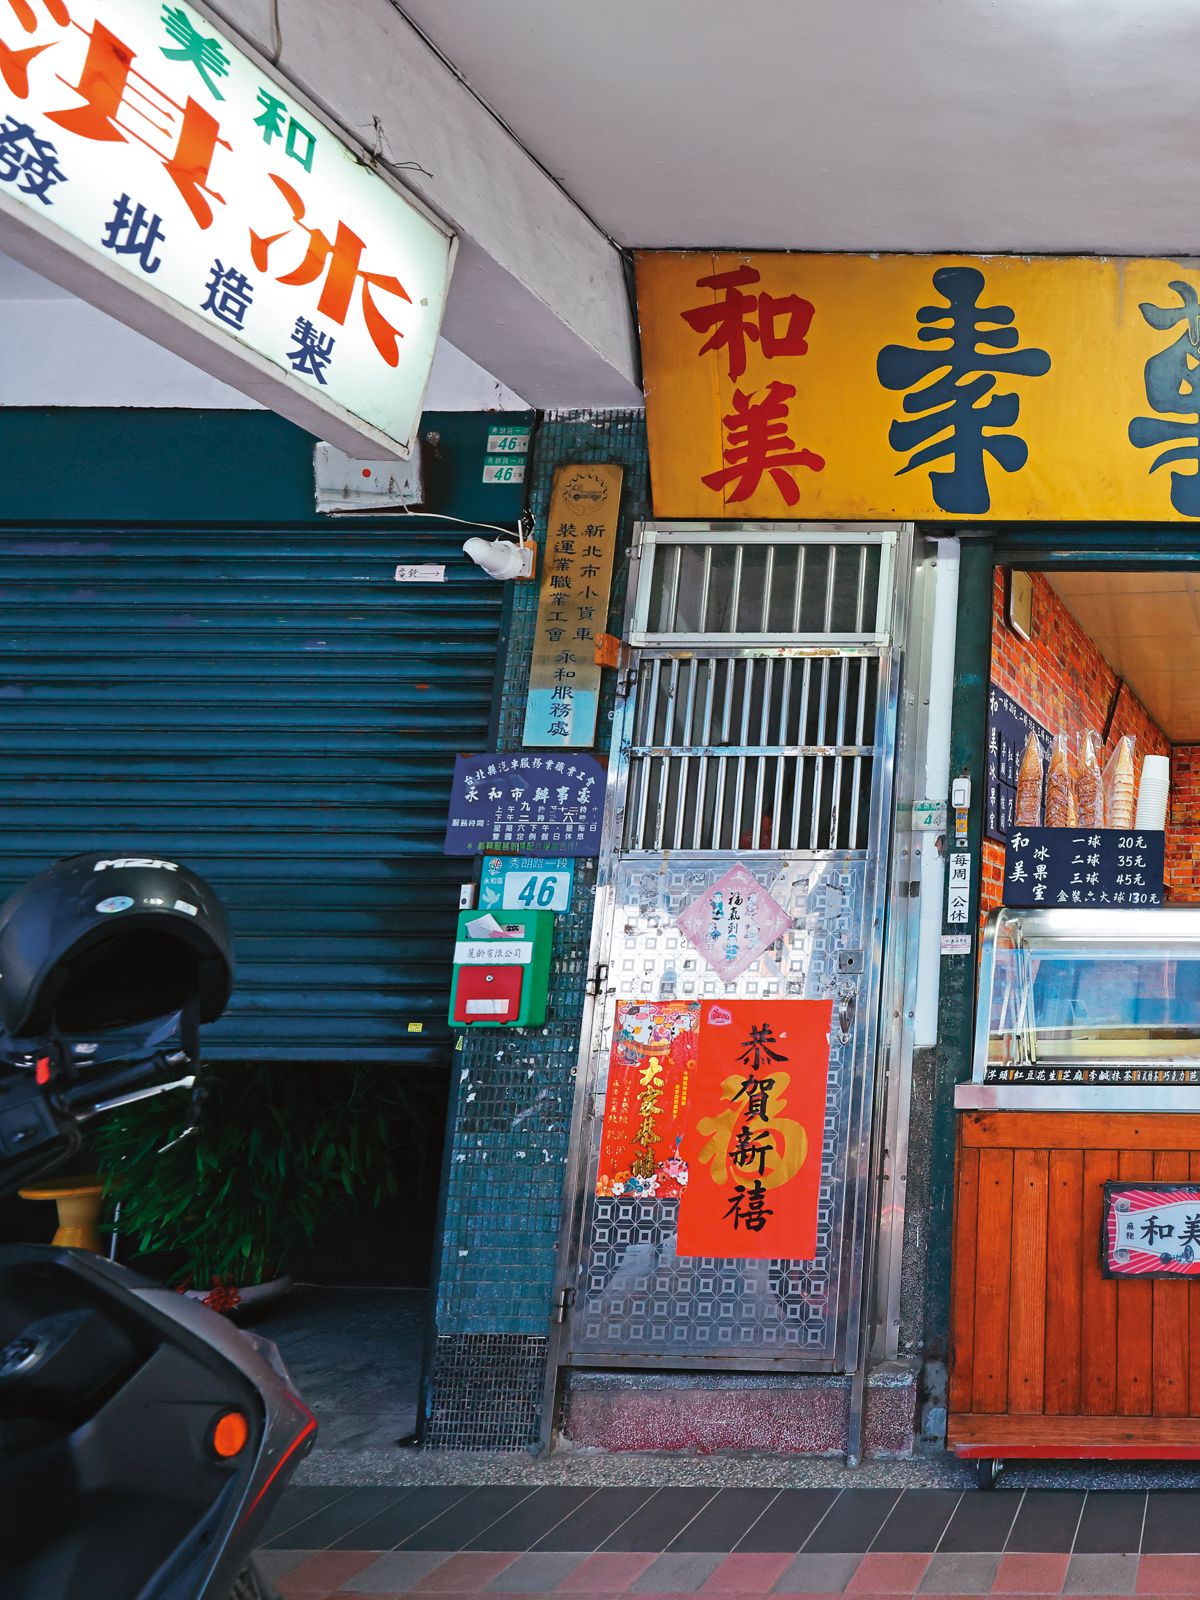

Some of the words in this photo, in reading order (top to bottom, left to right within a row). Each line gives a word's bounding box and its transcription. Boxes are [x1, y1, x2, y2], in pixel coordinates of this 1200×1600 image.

[681, 265, 825, 506] 和美
[498, 436, 517, 451] 46
[493, 467, 513, 481] 46
[545, 522, 578, 642] 裝運業職業工會
[572, 523, 605, 642] 新北市小貨車
[547, 648, 577, 737] 永和服務處
[1008, 831, 1030, 883] 和美
[1072, 834, 1102, 849] 一球
[1117, 835, 1148, 850] 20元
[509, 857, 568, 869] 秀朗路一段
[1032, 845, 1051, 901] 冰果室
[1071, 853, 1101, 868] 二球
[1117, 854, 1147, 868] 35元
[483, 877, 503, 885] 永和區
[518, 875, 558, 907] 46
[949, 854, 970, 922] 每周一公休
[1070, 872, 1100, 886] 三球
[1116, 873, 1146, 887] 45元
[988, 1069, 1008, 1081] 芋頭
[1013, 1070, 1035, 1081] 紅豆
[1036, 1069, 1057, 1081] 花生
[1062, 1069, 1084, 1081] 芝麻
[1163, 1070, 1185, 1082] 巧克力
[721, 1022, 790, 1234] 恭賀新禧
